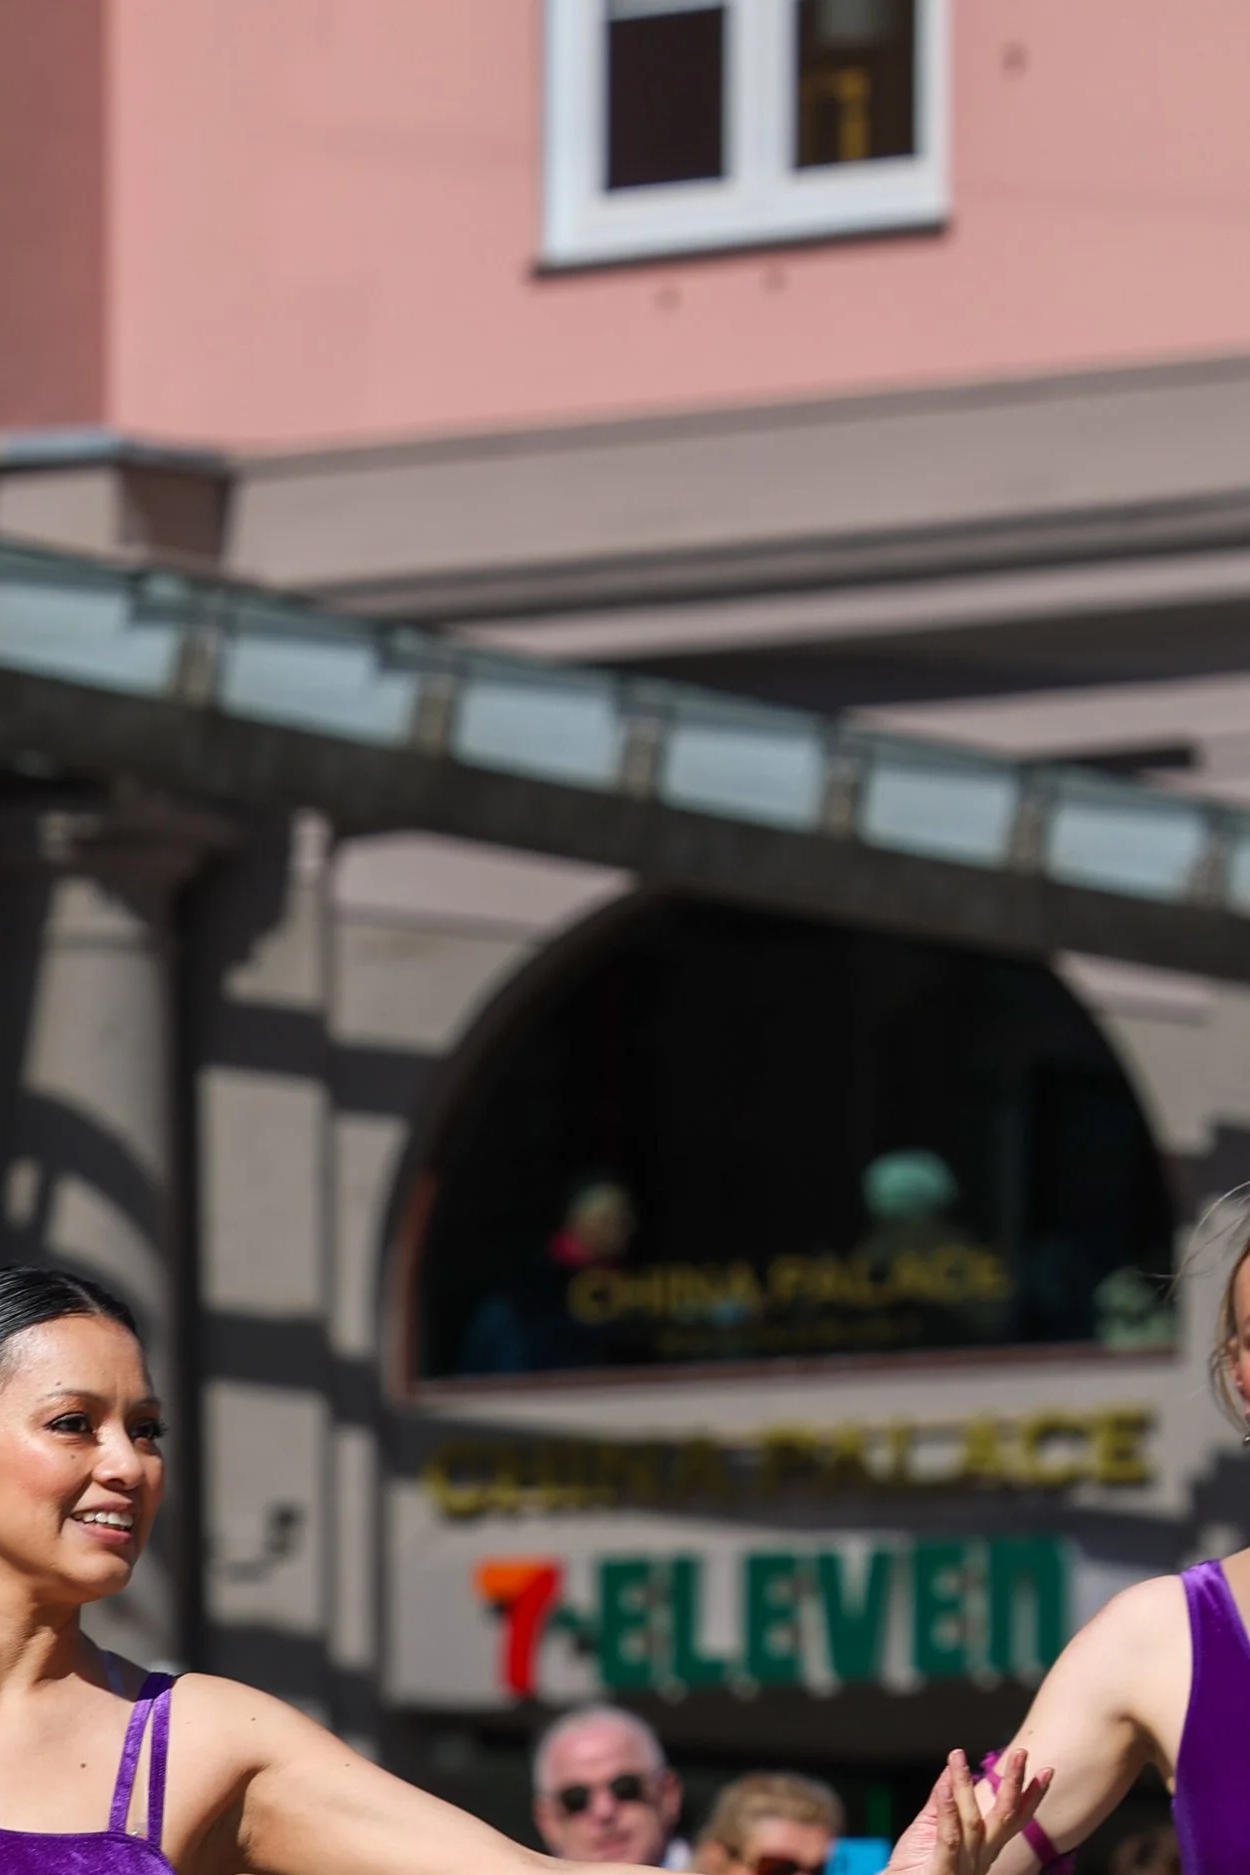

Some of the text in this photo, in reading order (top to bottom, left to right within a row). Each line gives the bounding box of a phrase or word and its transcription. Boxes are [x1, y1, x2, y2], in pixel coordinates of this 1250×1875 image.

[567, 1243, 1012, 1325] CHINA PALACE
[424, 1406, 1150, 1517] CHINA PALACE
